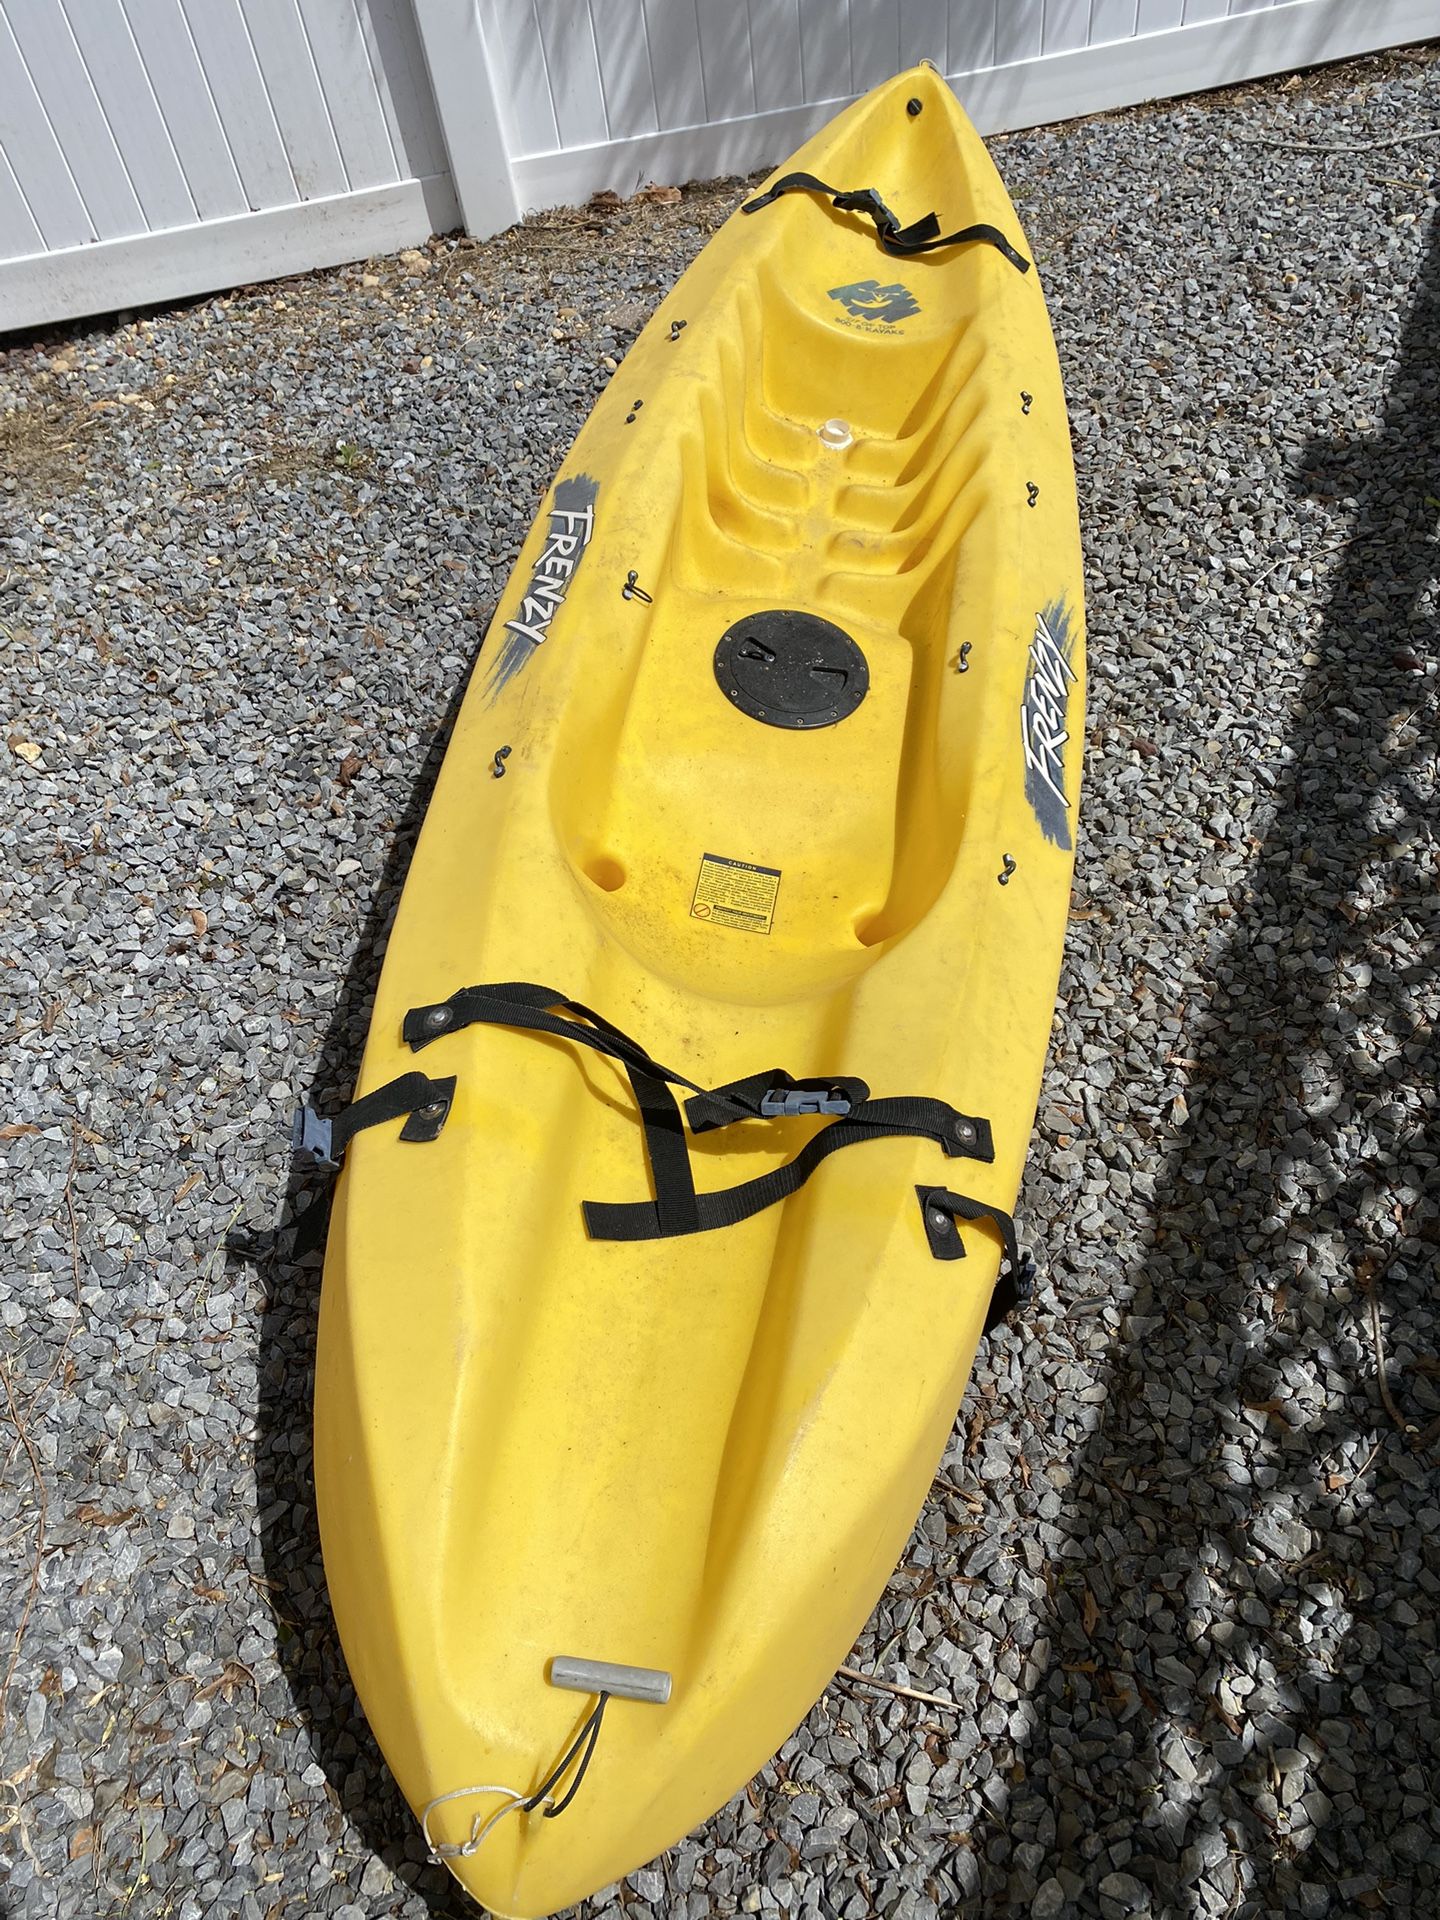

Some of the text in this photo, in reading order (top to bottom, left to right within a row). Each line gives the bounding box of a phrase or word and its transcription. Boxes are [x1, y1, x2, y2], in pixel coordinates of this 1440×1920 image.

[504, 504, 594, 647] FRENZY
[1020, 612, 1078, 808] FRENZY
[728, 860, 758, 871] CAUTION
